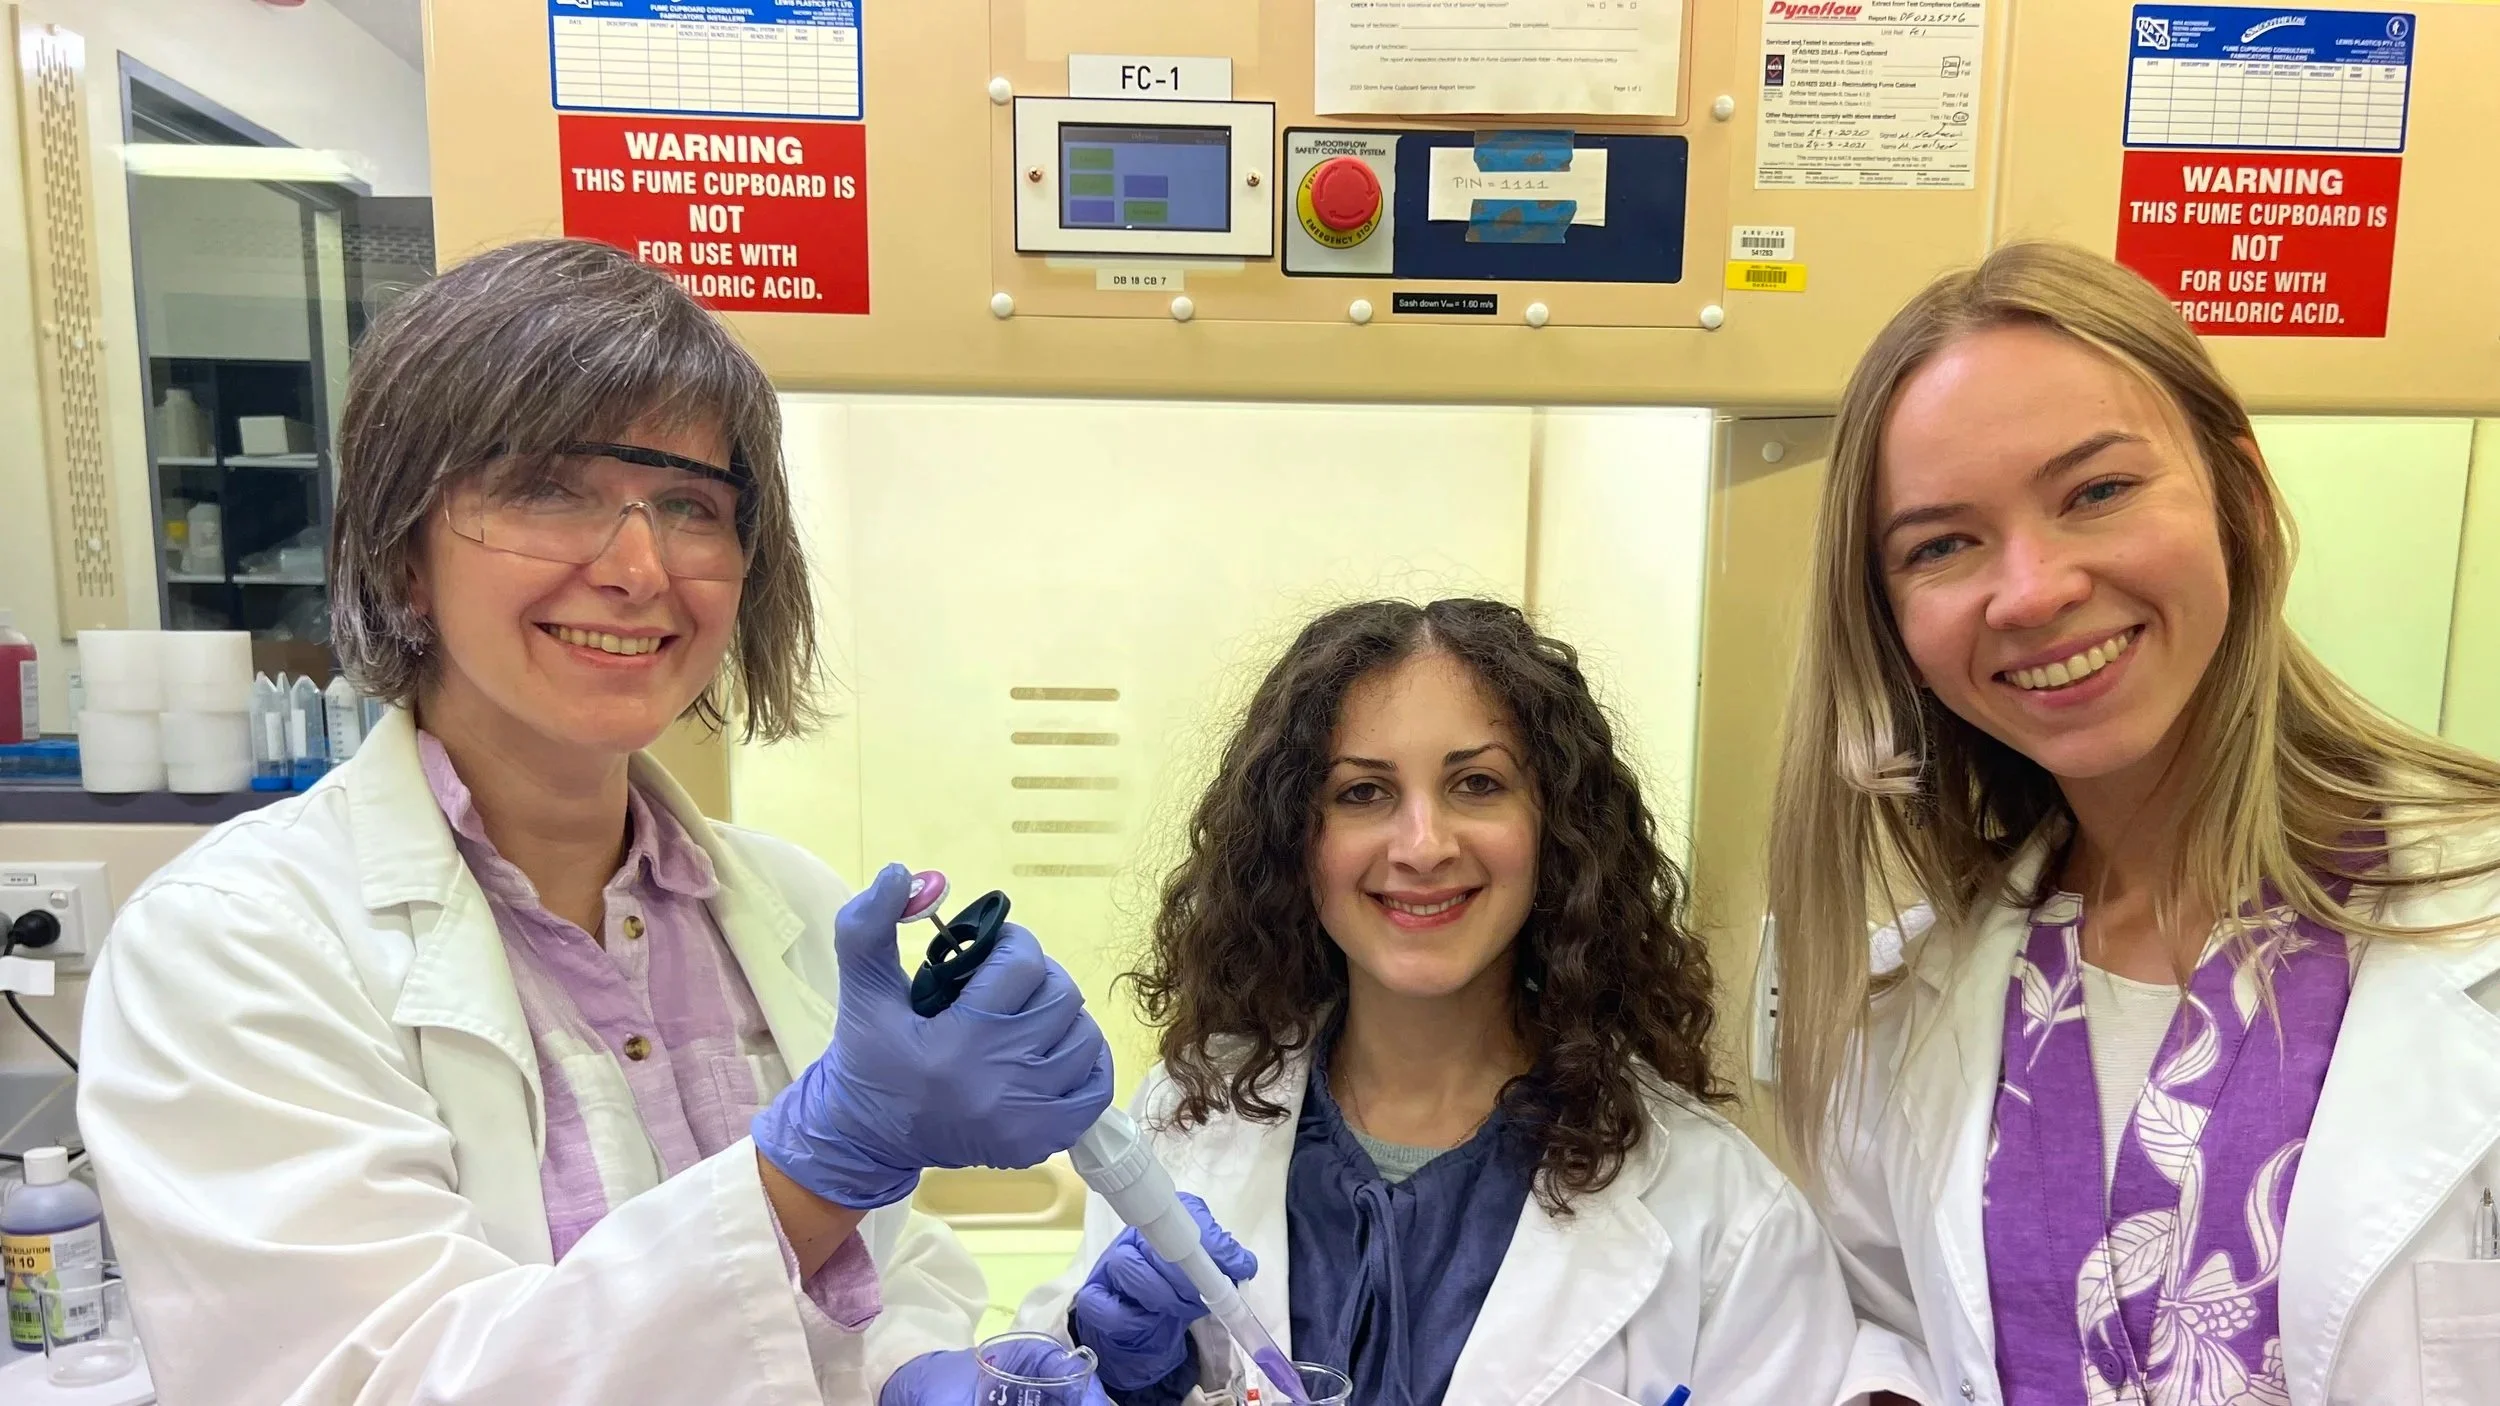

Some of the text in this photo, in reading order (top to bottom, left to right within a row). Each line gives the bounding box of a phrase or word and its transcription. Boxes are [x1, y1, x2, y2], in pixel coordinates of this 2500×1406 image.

[650, 4, 668, 12] FUME
[669, 5, 706, 13] CUPBOARD
[1769, 1, 1863, 20] Dynaflow
[2138, 19, 2168, 48] NATA
[2354, 39, 2381, 47] PLASTICS
[1121, 65, 1178, 90] FC-1
[624, 131, 804, 165] WARNING
[1314, 140, 1367, 148] SMOOTHFLOW
[572, 167, 855, 199] THIS FUME CUPBOARD IS
[1452, 176, 1483, 189] PIN
[1500, 179, 1549, 190] 1111
[2182, 165, 2343, 196] WARNING
[689, 204, 745, 234] NOT
[2130, 201, 2387, 228] THIS FUME CUPBOARD IS
[1306, 218, 1353, 244] EMERGENCY
[638, 241, 797, 267] FOR USE WITH
[2231, 234, 2283, 261] NOT
[675, 274, 823, 300] HLORIC ACID.
[1113, 275, 1167, 285] DB 18 CB 7
[2180, 270, 2327, 293] FOR USE WITH
[1399, 299, 1418, 307] Sash
[1419, 299, 1439, 307] down
[1479, 300, 1494, 308] m/s
[2171, 301, 2345, 324] ERCHLORIC ACID.
[14, 1247, 50, 1255] SOLUTION
[19, 1257, 34, 1269] 10
